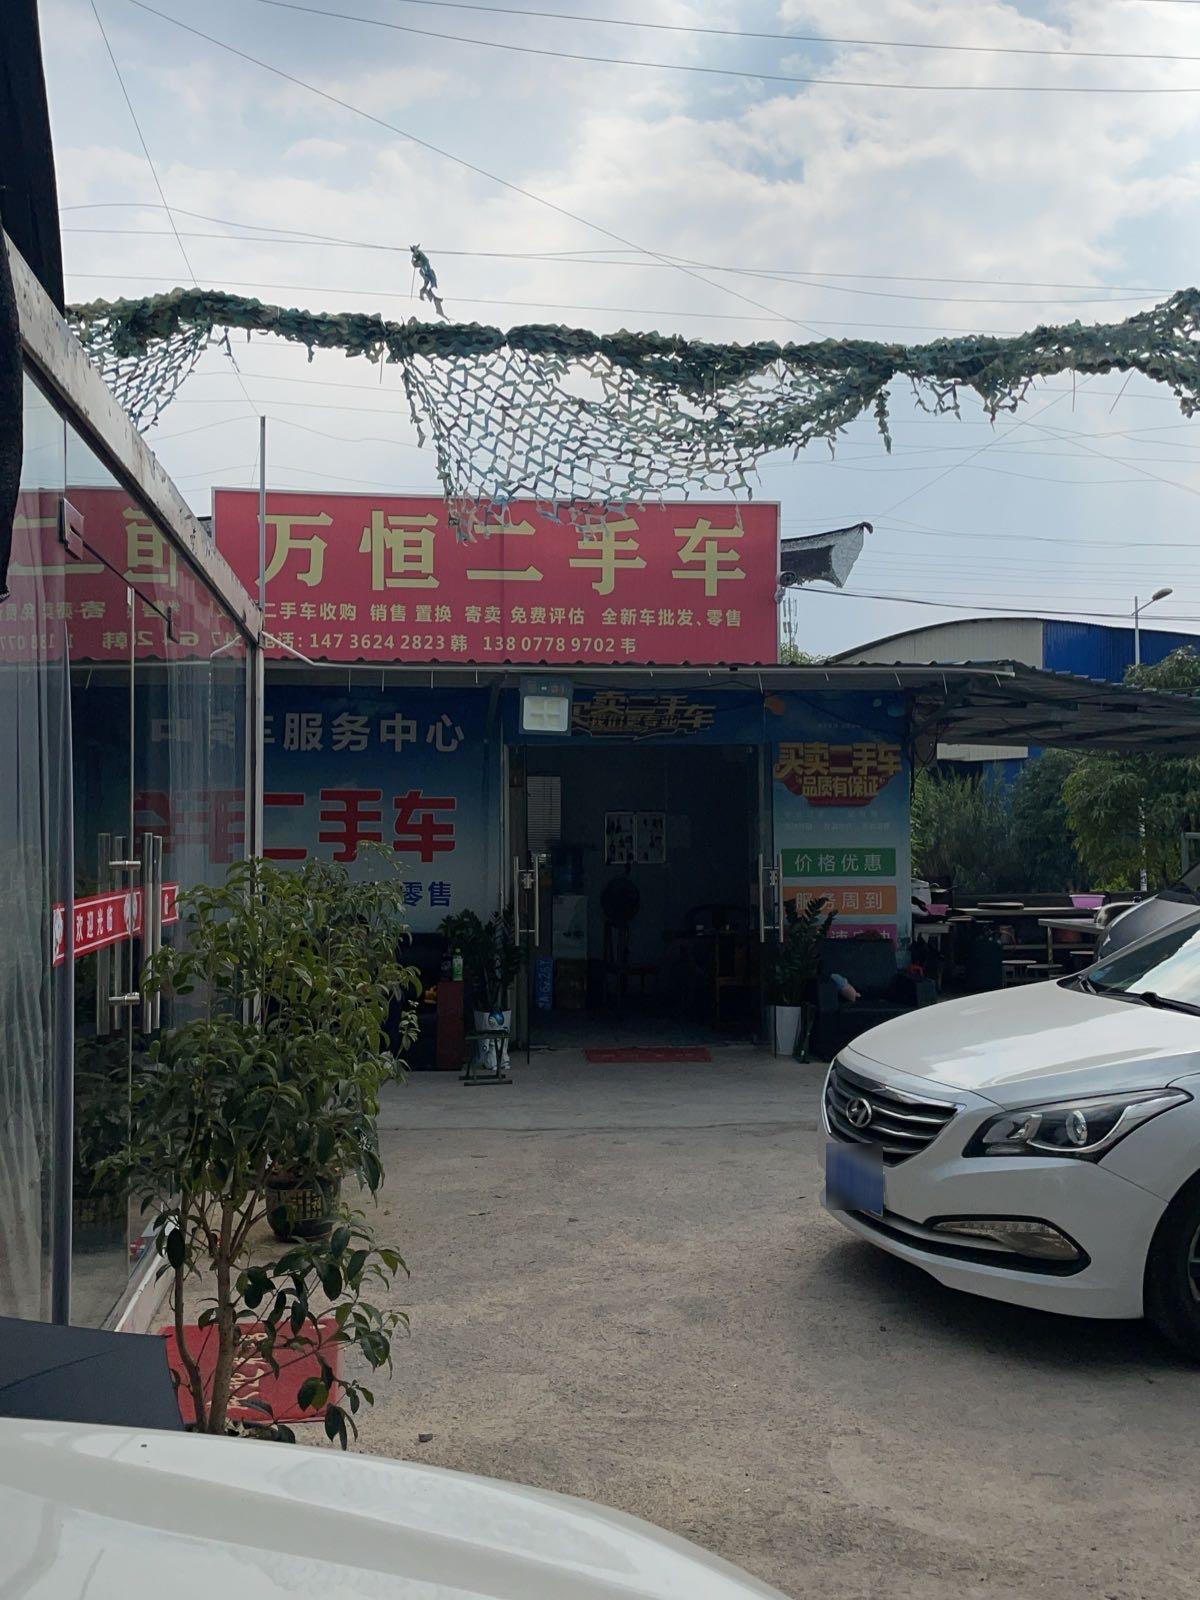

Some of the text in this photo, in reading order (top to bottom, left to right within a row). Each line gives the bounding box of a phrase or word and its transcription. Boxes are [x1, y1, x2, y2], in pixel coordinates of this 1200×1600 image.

[254, 510, 746, 597] 万恒二手车
[264, 602, 742, 627] 二手车收购 销售 置换 寄卖 免费评估 全新车批发、零售
[775, 742, 902, 777] 买卖二手车
[263, 789, 456, 863] 二手车
[795, 854, 882, 872] 价格优惠
[402, 881, 452, 907] 零售
